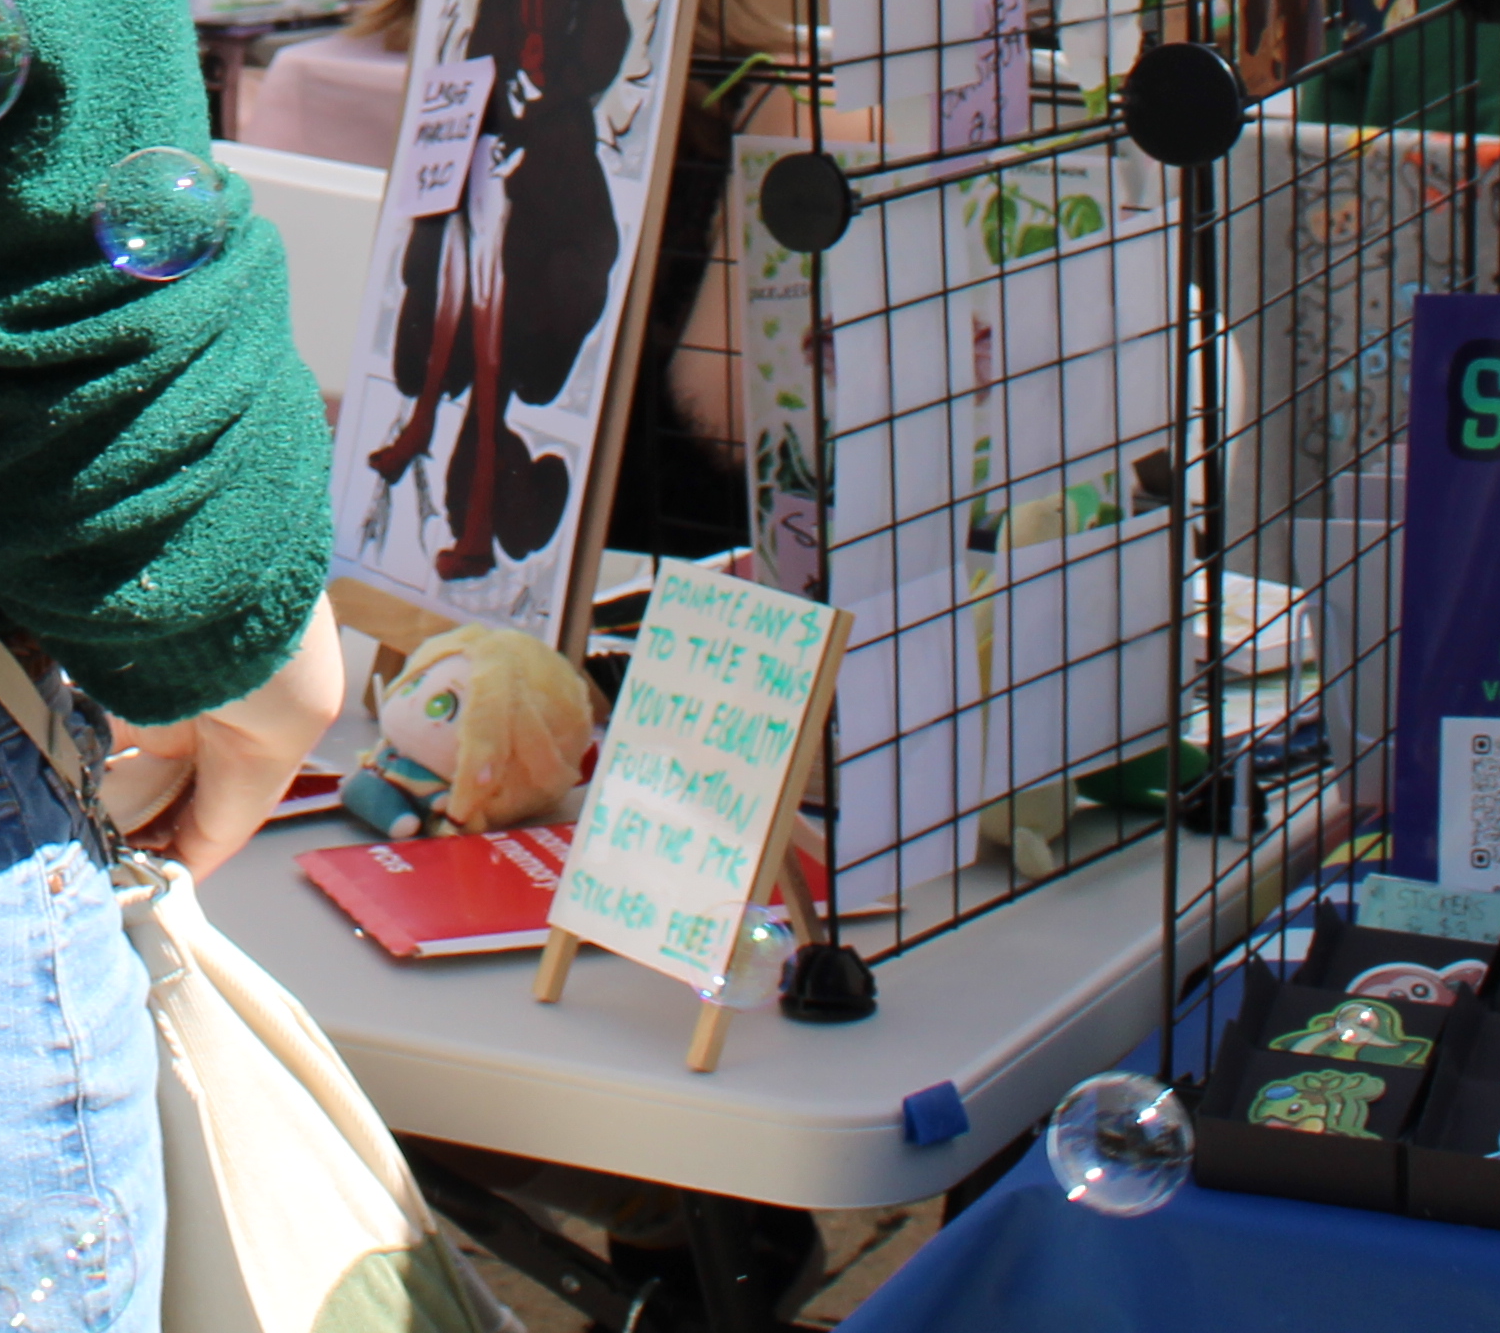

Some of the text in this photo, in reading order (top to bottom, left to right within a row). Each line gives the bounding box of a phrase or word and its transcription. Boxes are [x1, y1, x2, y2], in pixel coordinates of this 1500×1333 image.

[646, 624, 677, 662] TO
[687, 635, 747, 685] THE
[658, 574, 824, 661] DONATE ANY $
[624, 677, 796, 768] YOUTH EQUALITY
[607, 741, 765, 834] FOUNDATION
[610, 807, 653, 853] GET
[667, 909, 731, 961] FREE!
